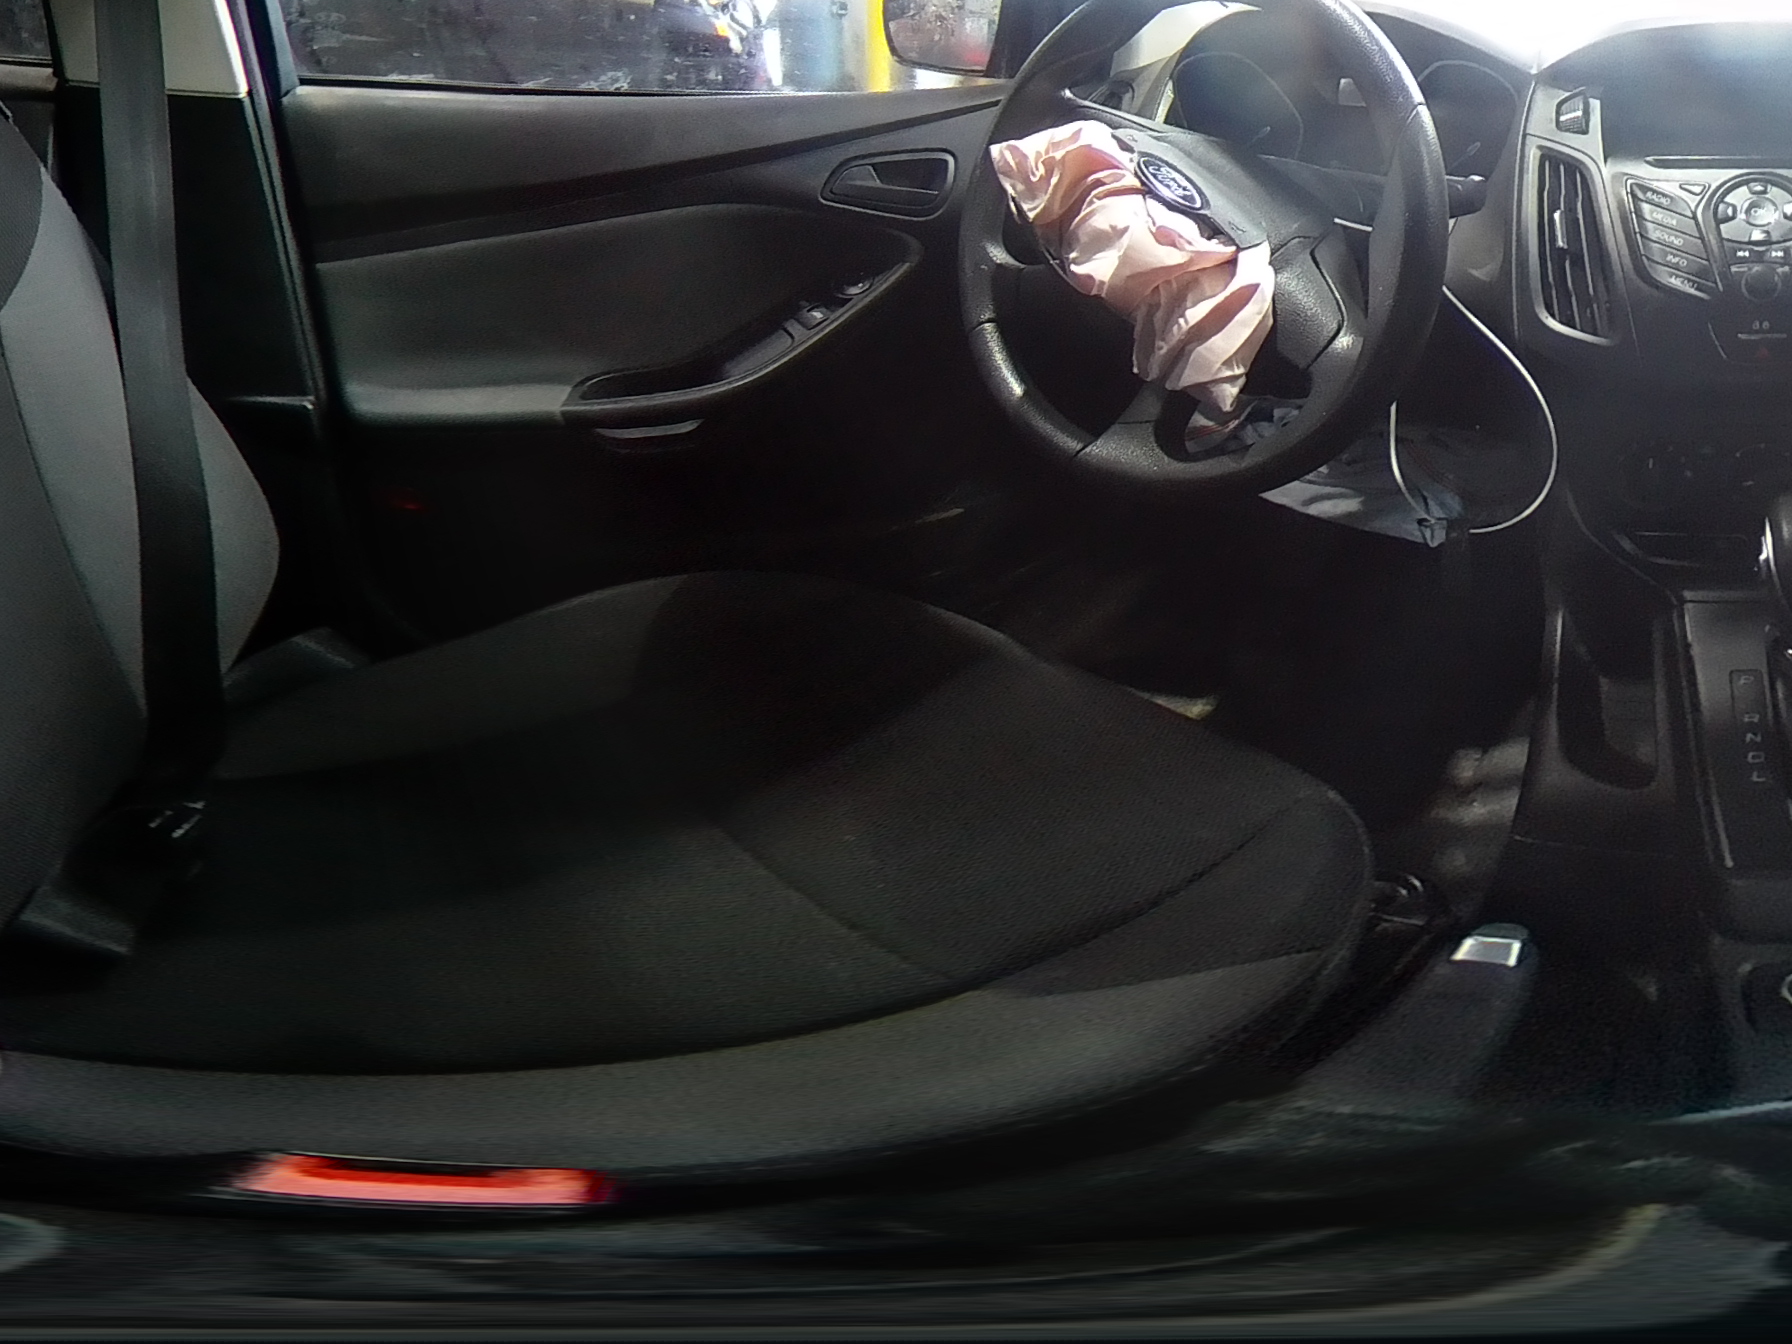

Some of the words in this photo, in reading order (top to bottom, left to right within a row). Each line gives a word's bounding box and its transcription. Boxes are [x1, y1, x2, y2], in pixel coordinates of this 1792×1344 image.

[1148, 165, 1192, 197] Ford
[1645, 190, 1672, 206] RADIO
[1652, 211, 1677, 227] MEDIA
[1654, 229, 1684, 247] SOUND
[1665, 254, 1688, 267] INFO
[1739, 675, 1754, 685] P
[1746, 732, 1762, 744] N
[1751, 771, 1766, 782] L
